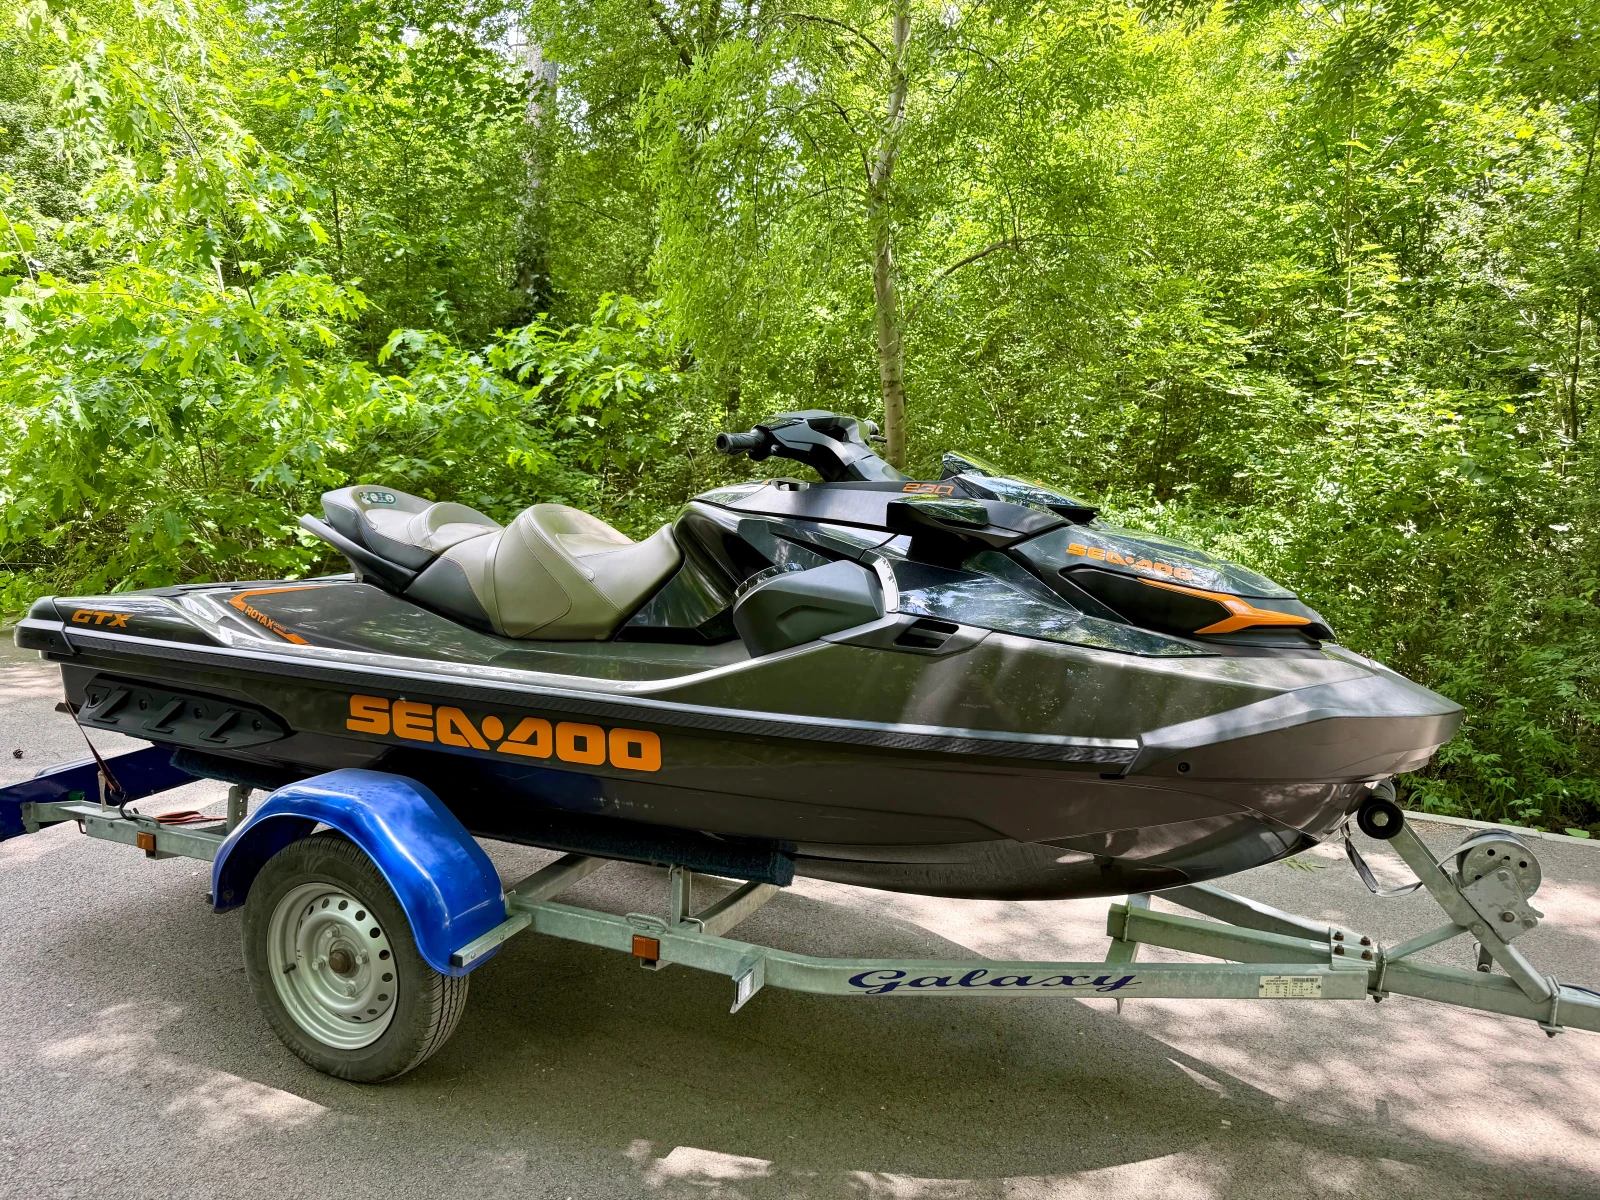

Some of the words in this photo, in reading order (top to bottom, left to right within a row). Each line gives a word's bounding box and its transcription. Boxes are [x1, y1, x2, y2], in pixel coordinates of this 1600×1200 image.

[72, 610, 135, 628] GTX
[245, 605, 274, 629] ROTAX
[848, 969, 1142, 995] Galaxy
